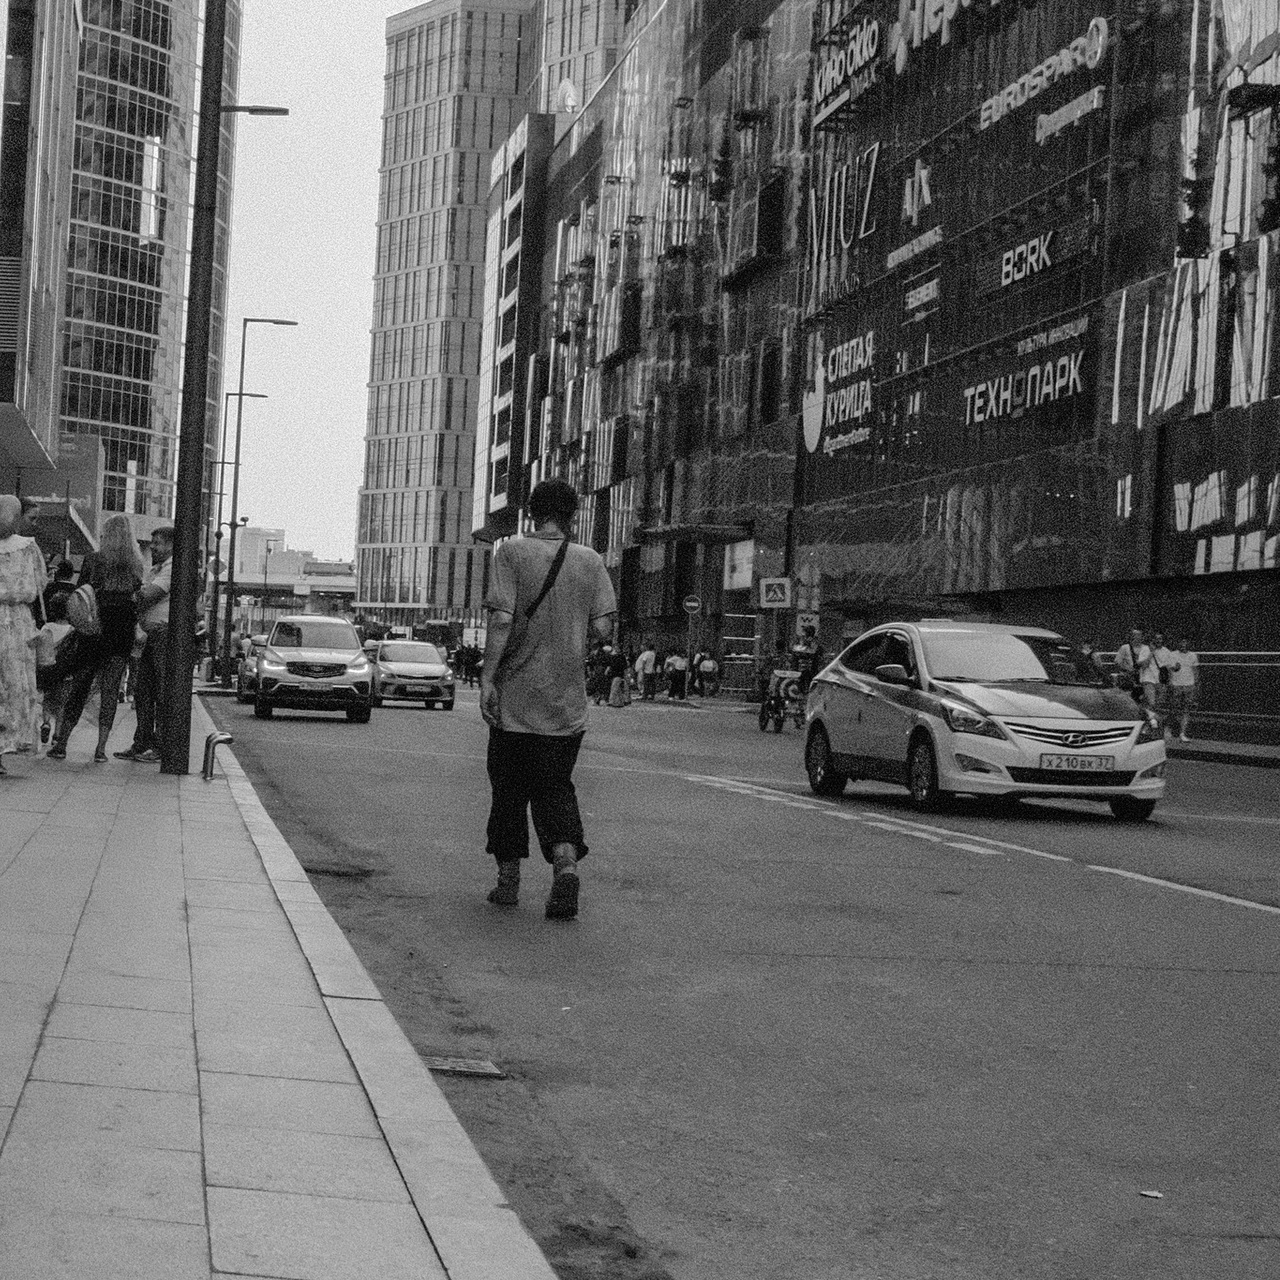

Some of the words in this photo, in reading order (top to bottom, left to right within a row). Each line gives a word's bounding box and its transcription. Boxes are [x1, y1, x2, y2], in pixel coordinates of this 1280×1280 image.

[979, 36, 1088, 131] EUROSPAR
[1001, 230, 1054, 287] BORK
[827, 330, 874, 384] СЛЕПАЯ
[825, 377, 873, 428] КУРИЦА
[963, 349, 1085, 426] ТЕХНОПАРК
